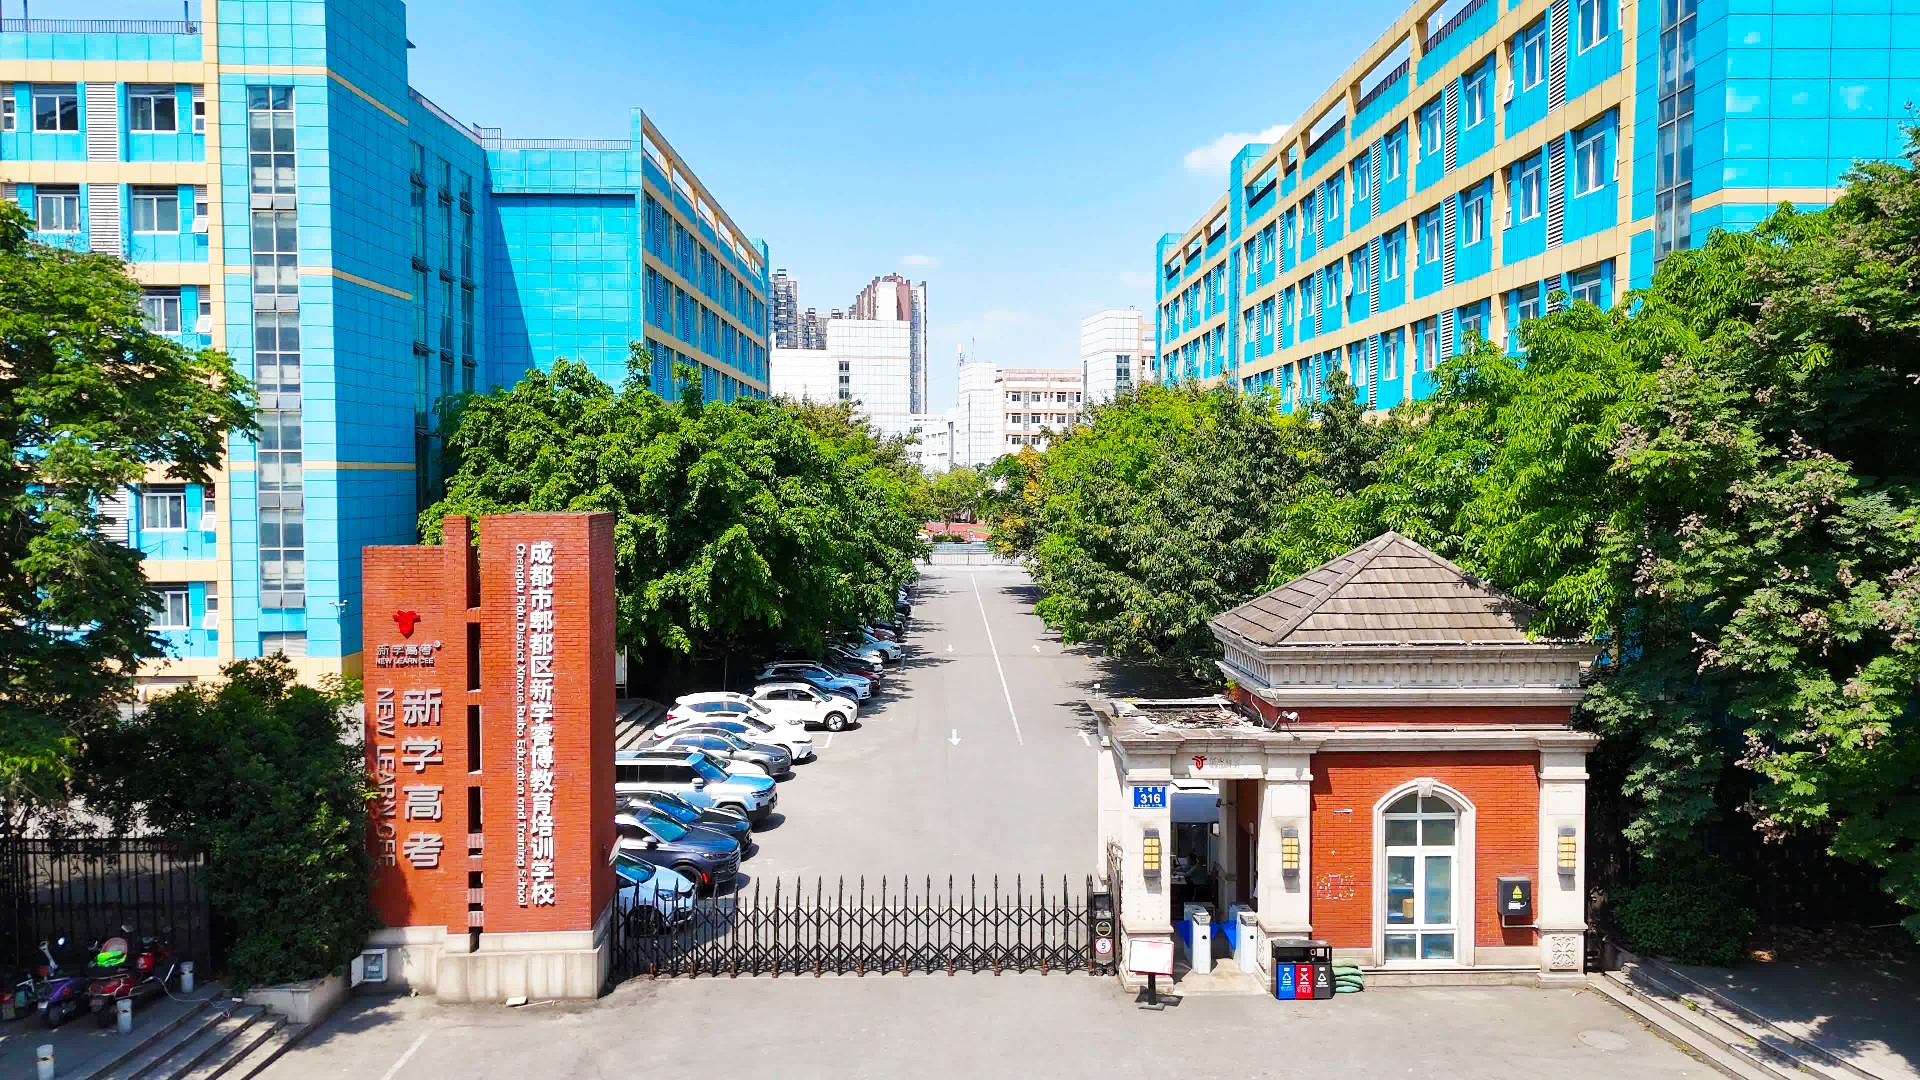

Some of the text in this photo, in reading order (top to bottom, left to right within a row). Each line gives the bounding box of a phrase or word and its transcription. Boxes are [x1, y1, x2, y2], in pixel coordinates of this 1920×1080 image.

[376, 657, 435, 665] NEW LEARN CEE
[376, 688, 395, 736] NEW
[515, 544, 528, 906] Chengdu Pidu District Xinxue Ruibo Education and Training School
[529, 541, 555, 905] 成都市郫都区新学睿博教育培训学校
[376, 745, 396, 818] LEARN
[402, 688, 444, 868] 新学高考
[1140, 793, 1161, 804] 316
[1101, 942, 1106, 950] 5
